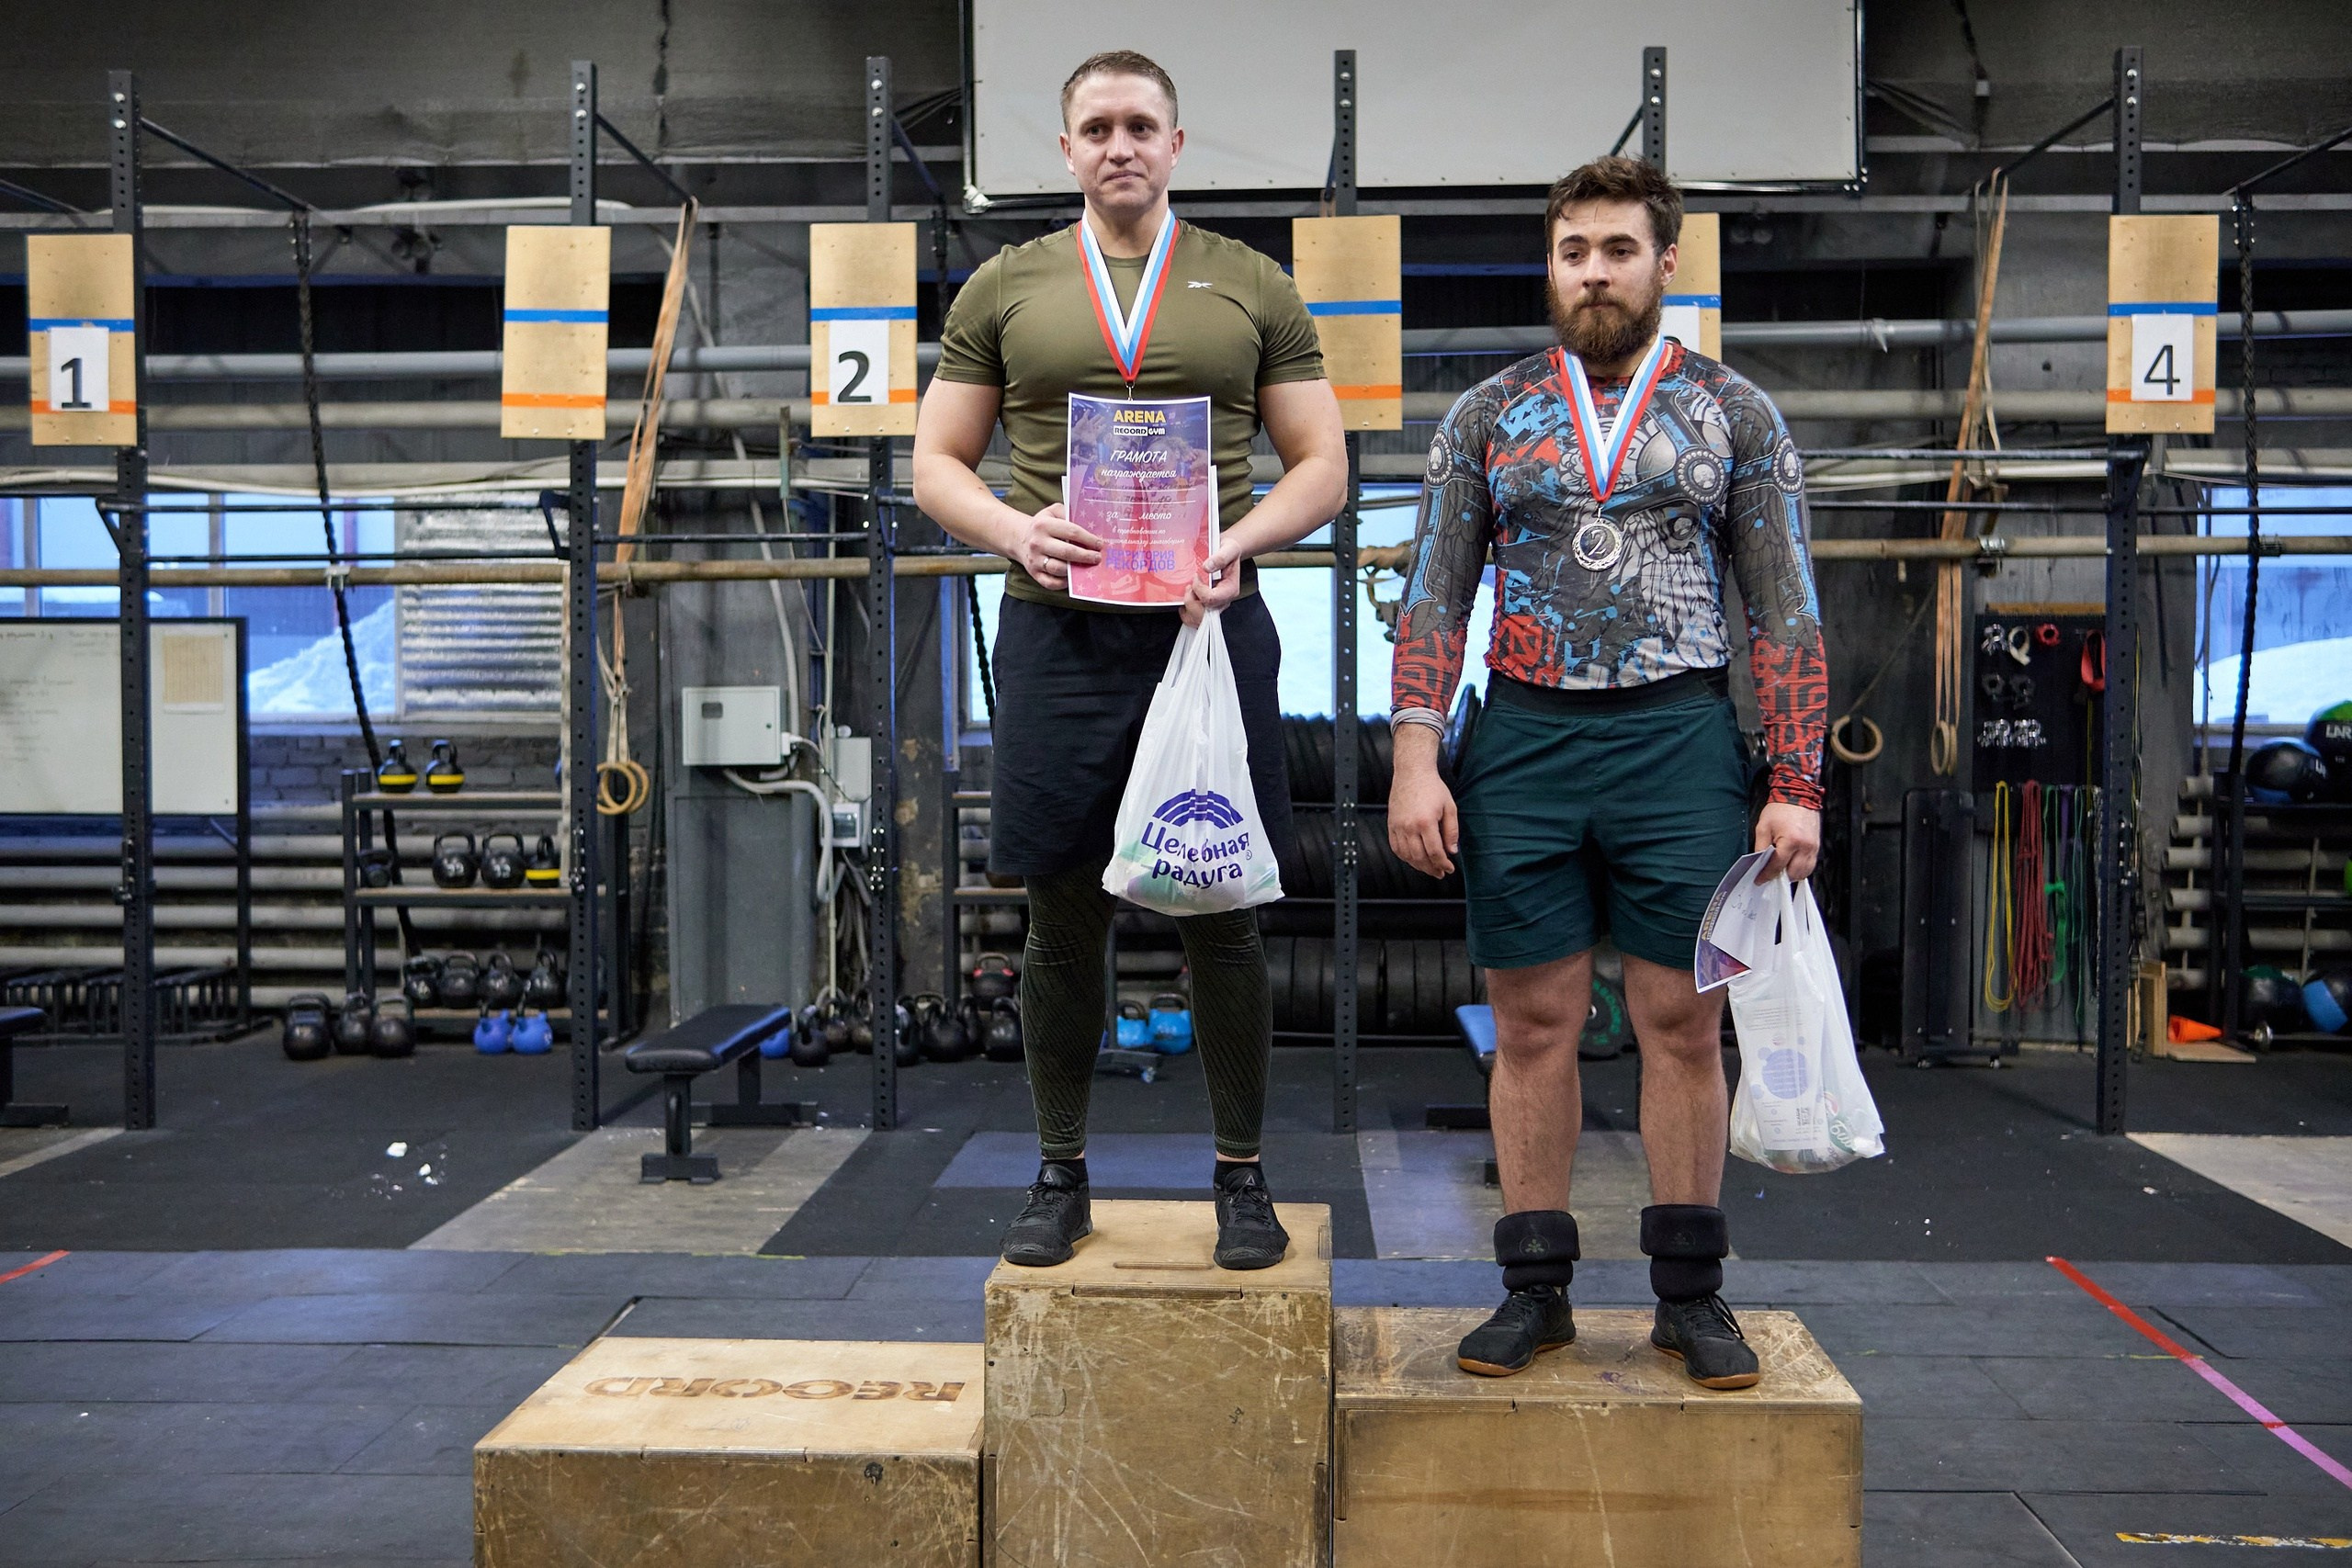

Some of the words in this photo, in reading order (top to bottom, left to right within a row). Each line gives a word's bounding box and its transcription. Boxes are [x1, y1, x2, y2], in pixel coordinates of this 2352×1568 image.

[837, 350, 872, 402] 2
[2143, 344, 2180, 395] 4
[61, 357, 92, 409] 1
[1113, 410, 1167, 423] ARENA
[1114, 427, 1147, 435] RECORD
[1148, 427, 1166, 435] GYM
[1110, 450, 1168, 463] ГРАМОТА
[1101, 468, 1177, 483] награждается
[1105, 511, 1119, 522] за
[1138, 512, 1172, 521] место
[1588, 528, 1607, 557] 2
[1106, 548, 1175, 560] ТЕРРИТОРИЯ
[1106, 558, 1175, 572] РЕКОРДОВ
[1141, 821, 1250, 863] Целебная
[1151, 858, 1243, 889] радуга
[582, 1376, 966, 1403] RECORD
